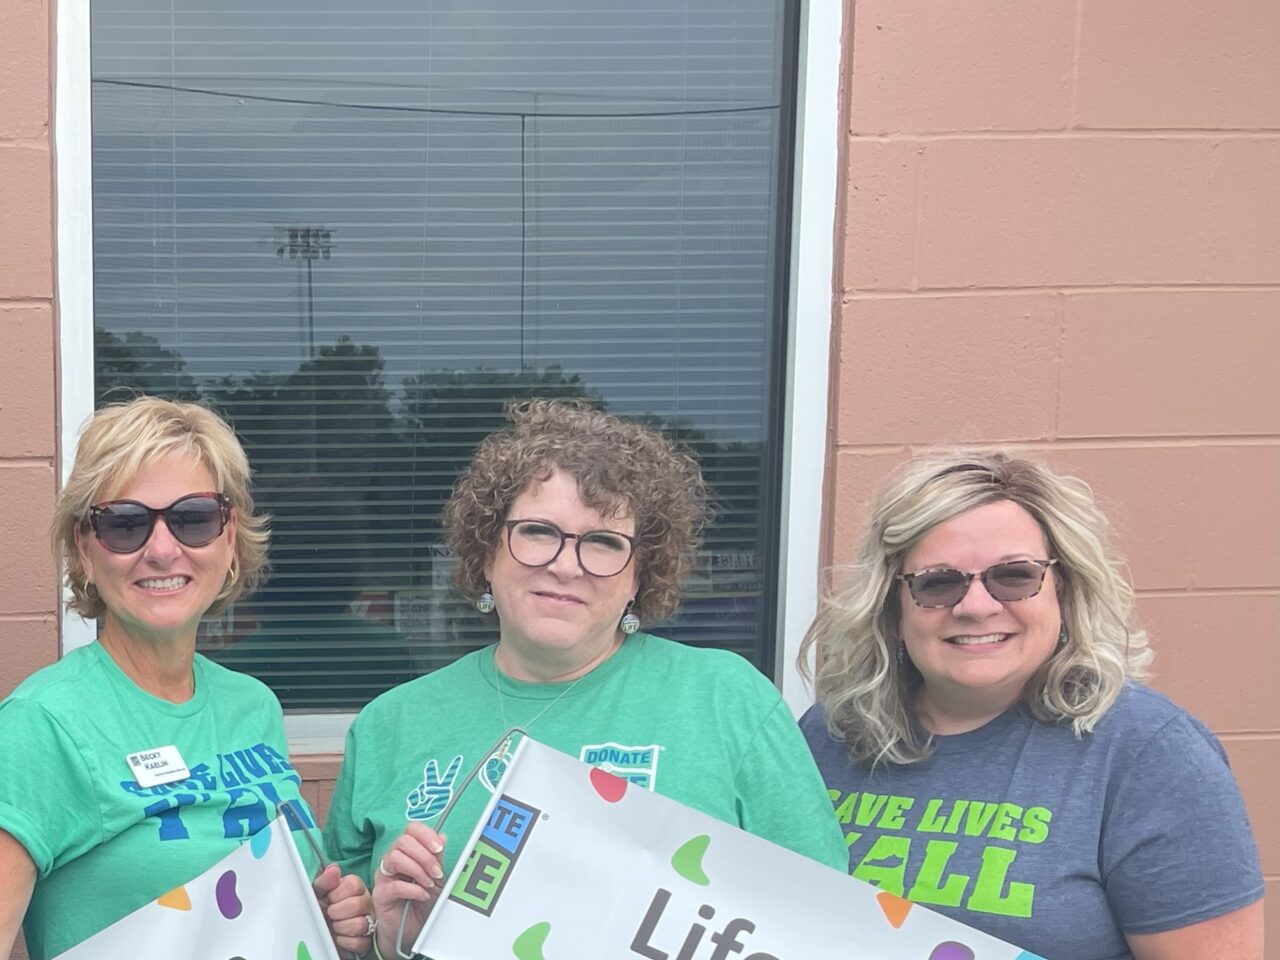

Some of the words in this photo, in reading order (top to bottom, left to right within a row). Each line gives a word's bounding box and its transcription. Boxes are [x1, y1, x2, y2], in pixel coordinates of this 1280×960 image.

[139, 752, 161, 762] BECKY
[586, 749, 651, 765] DONATE
[486, 805, 527, 839] TE
[916, 798, 1053, 844] LIVES
